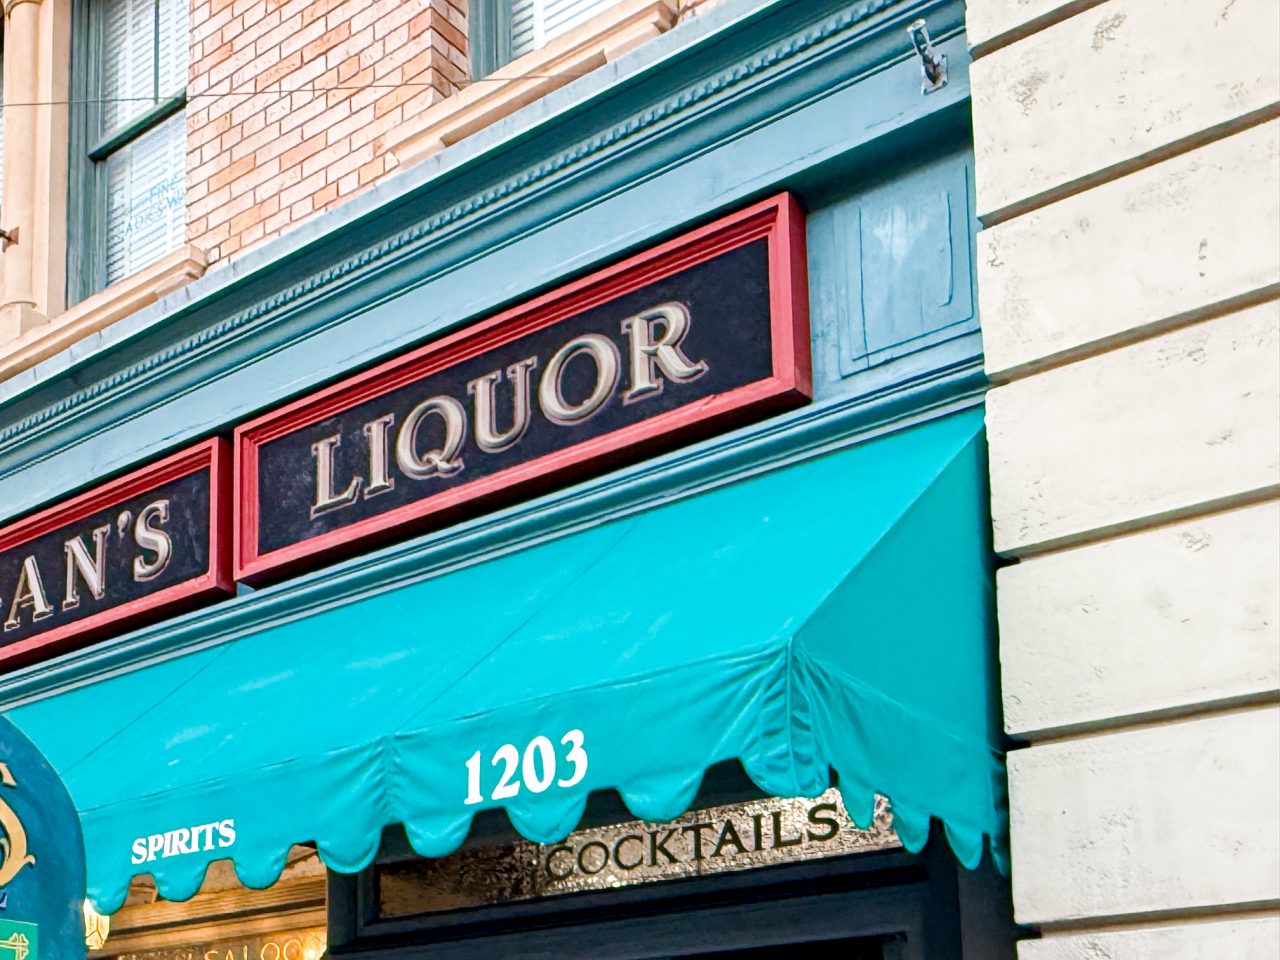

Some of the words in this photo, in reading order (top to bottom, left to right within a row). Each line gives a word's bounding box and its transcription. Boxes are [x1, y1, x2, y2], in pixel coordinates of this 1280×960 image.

[310, 301, 709, 520] LIQUOR
[463, 729, 589, 805] 1203
[131, 819, 236, 865] SPIRITS
[546, 803, 840, 880] COCKTAILS
